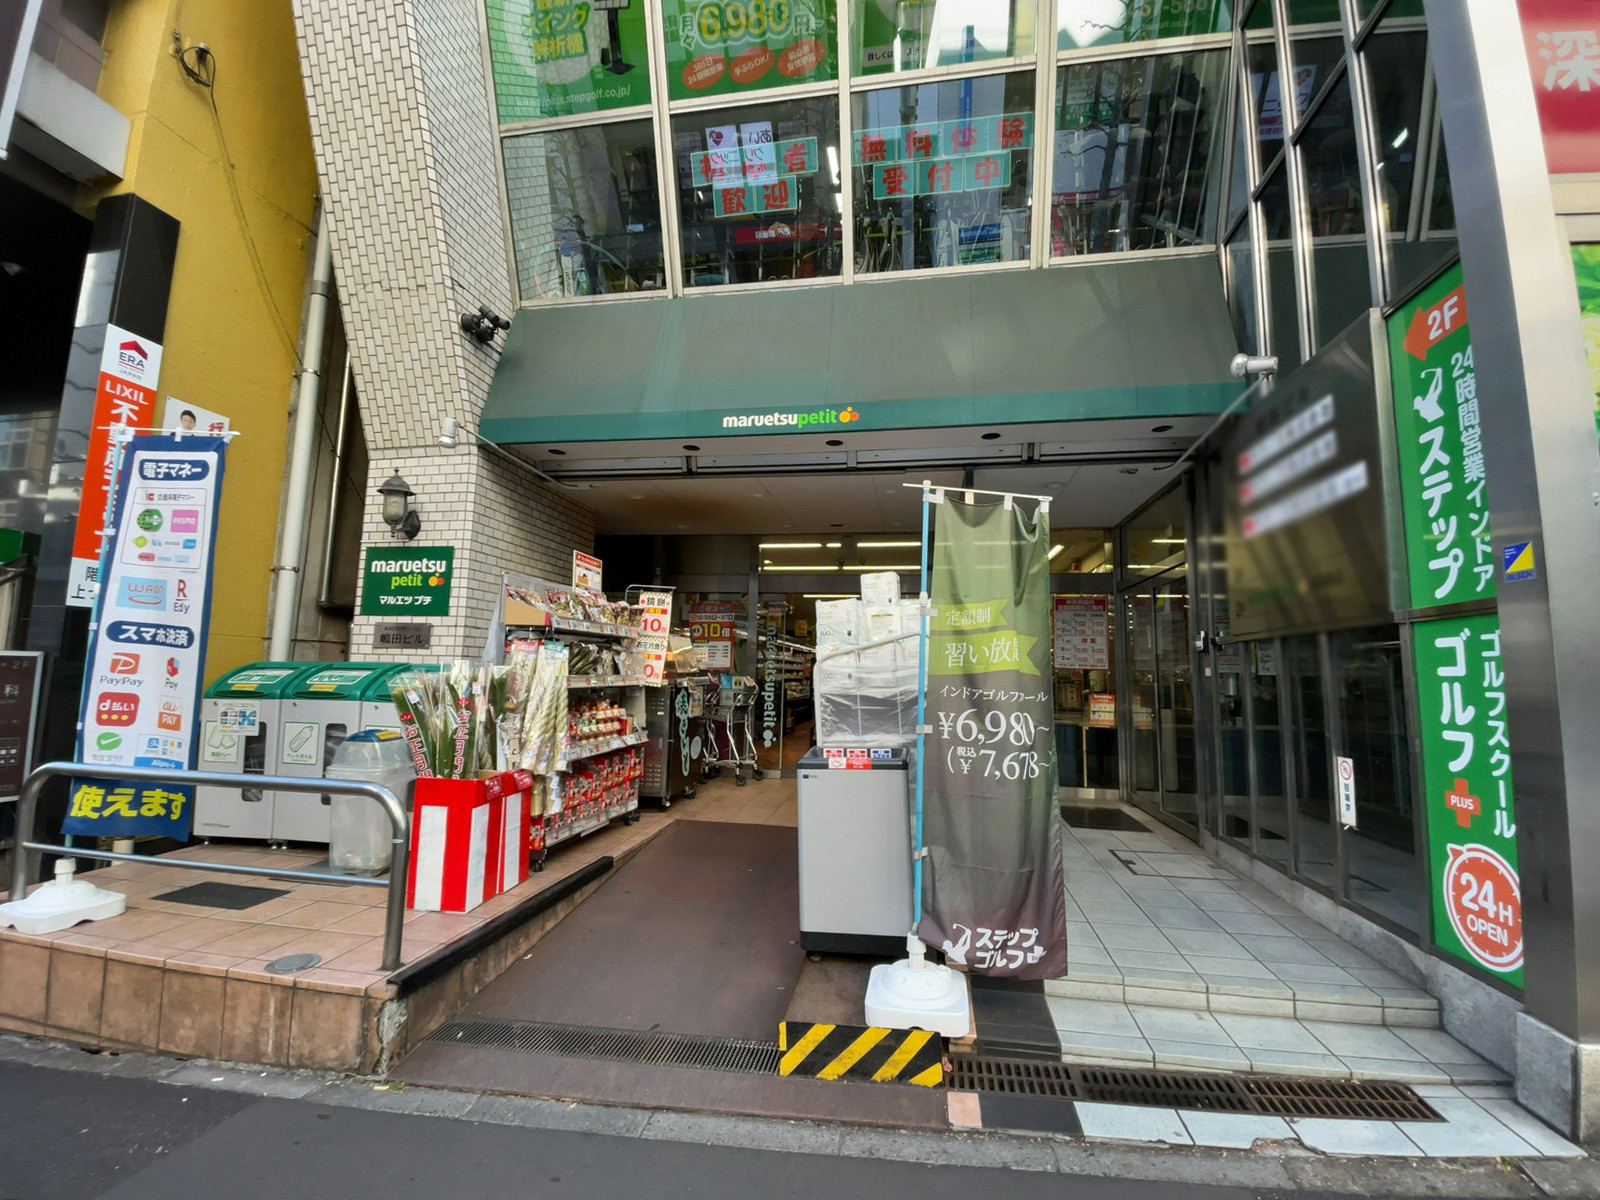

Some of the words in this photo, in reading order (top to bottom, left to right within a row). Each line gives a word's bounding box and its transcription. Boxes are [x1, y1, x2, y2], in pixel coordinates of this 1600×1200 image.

[860, 116, 1027, 162] 無料体験
[882, 156, 1001, 196] 受付中
[721, 179, 789, 215] 歓迎
[1427, 296, 1459, 341] 2F
[119, 351, 145, 369] ERA
[105, 379, 149, 406] LIXIL
[142, 461, 202, 479] 電子マネー
[1419, 426, 1465, 600] ステップ
[370, 557, 447, 573] maruetsu
[390, 573, 423, 590] petit
[173, 601, 190, 614] Edy
[378, 595, 413, 605] マルエツ
[413, 594, 432, 605] プチ
[945, 606, 992, 627] 定額制
[118, 625, 189, 647] スマホ決済
[100, 675, 145, 688] PayPay
[99, 700, 136, 712] d払い
[1433, 627, 1476, 773] ゴルフ
[70, 784, 187, 820] 使えます
[1450, 794, 1475, 811] PLUS
[975, 927, 1039, 949] ステップ
[1465, 913, 1510, 947] OPEN
[974, 949, 1025, 969] ゴルフ
